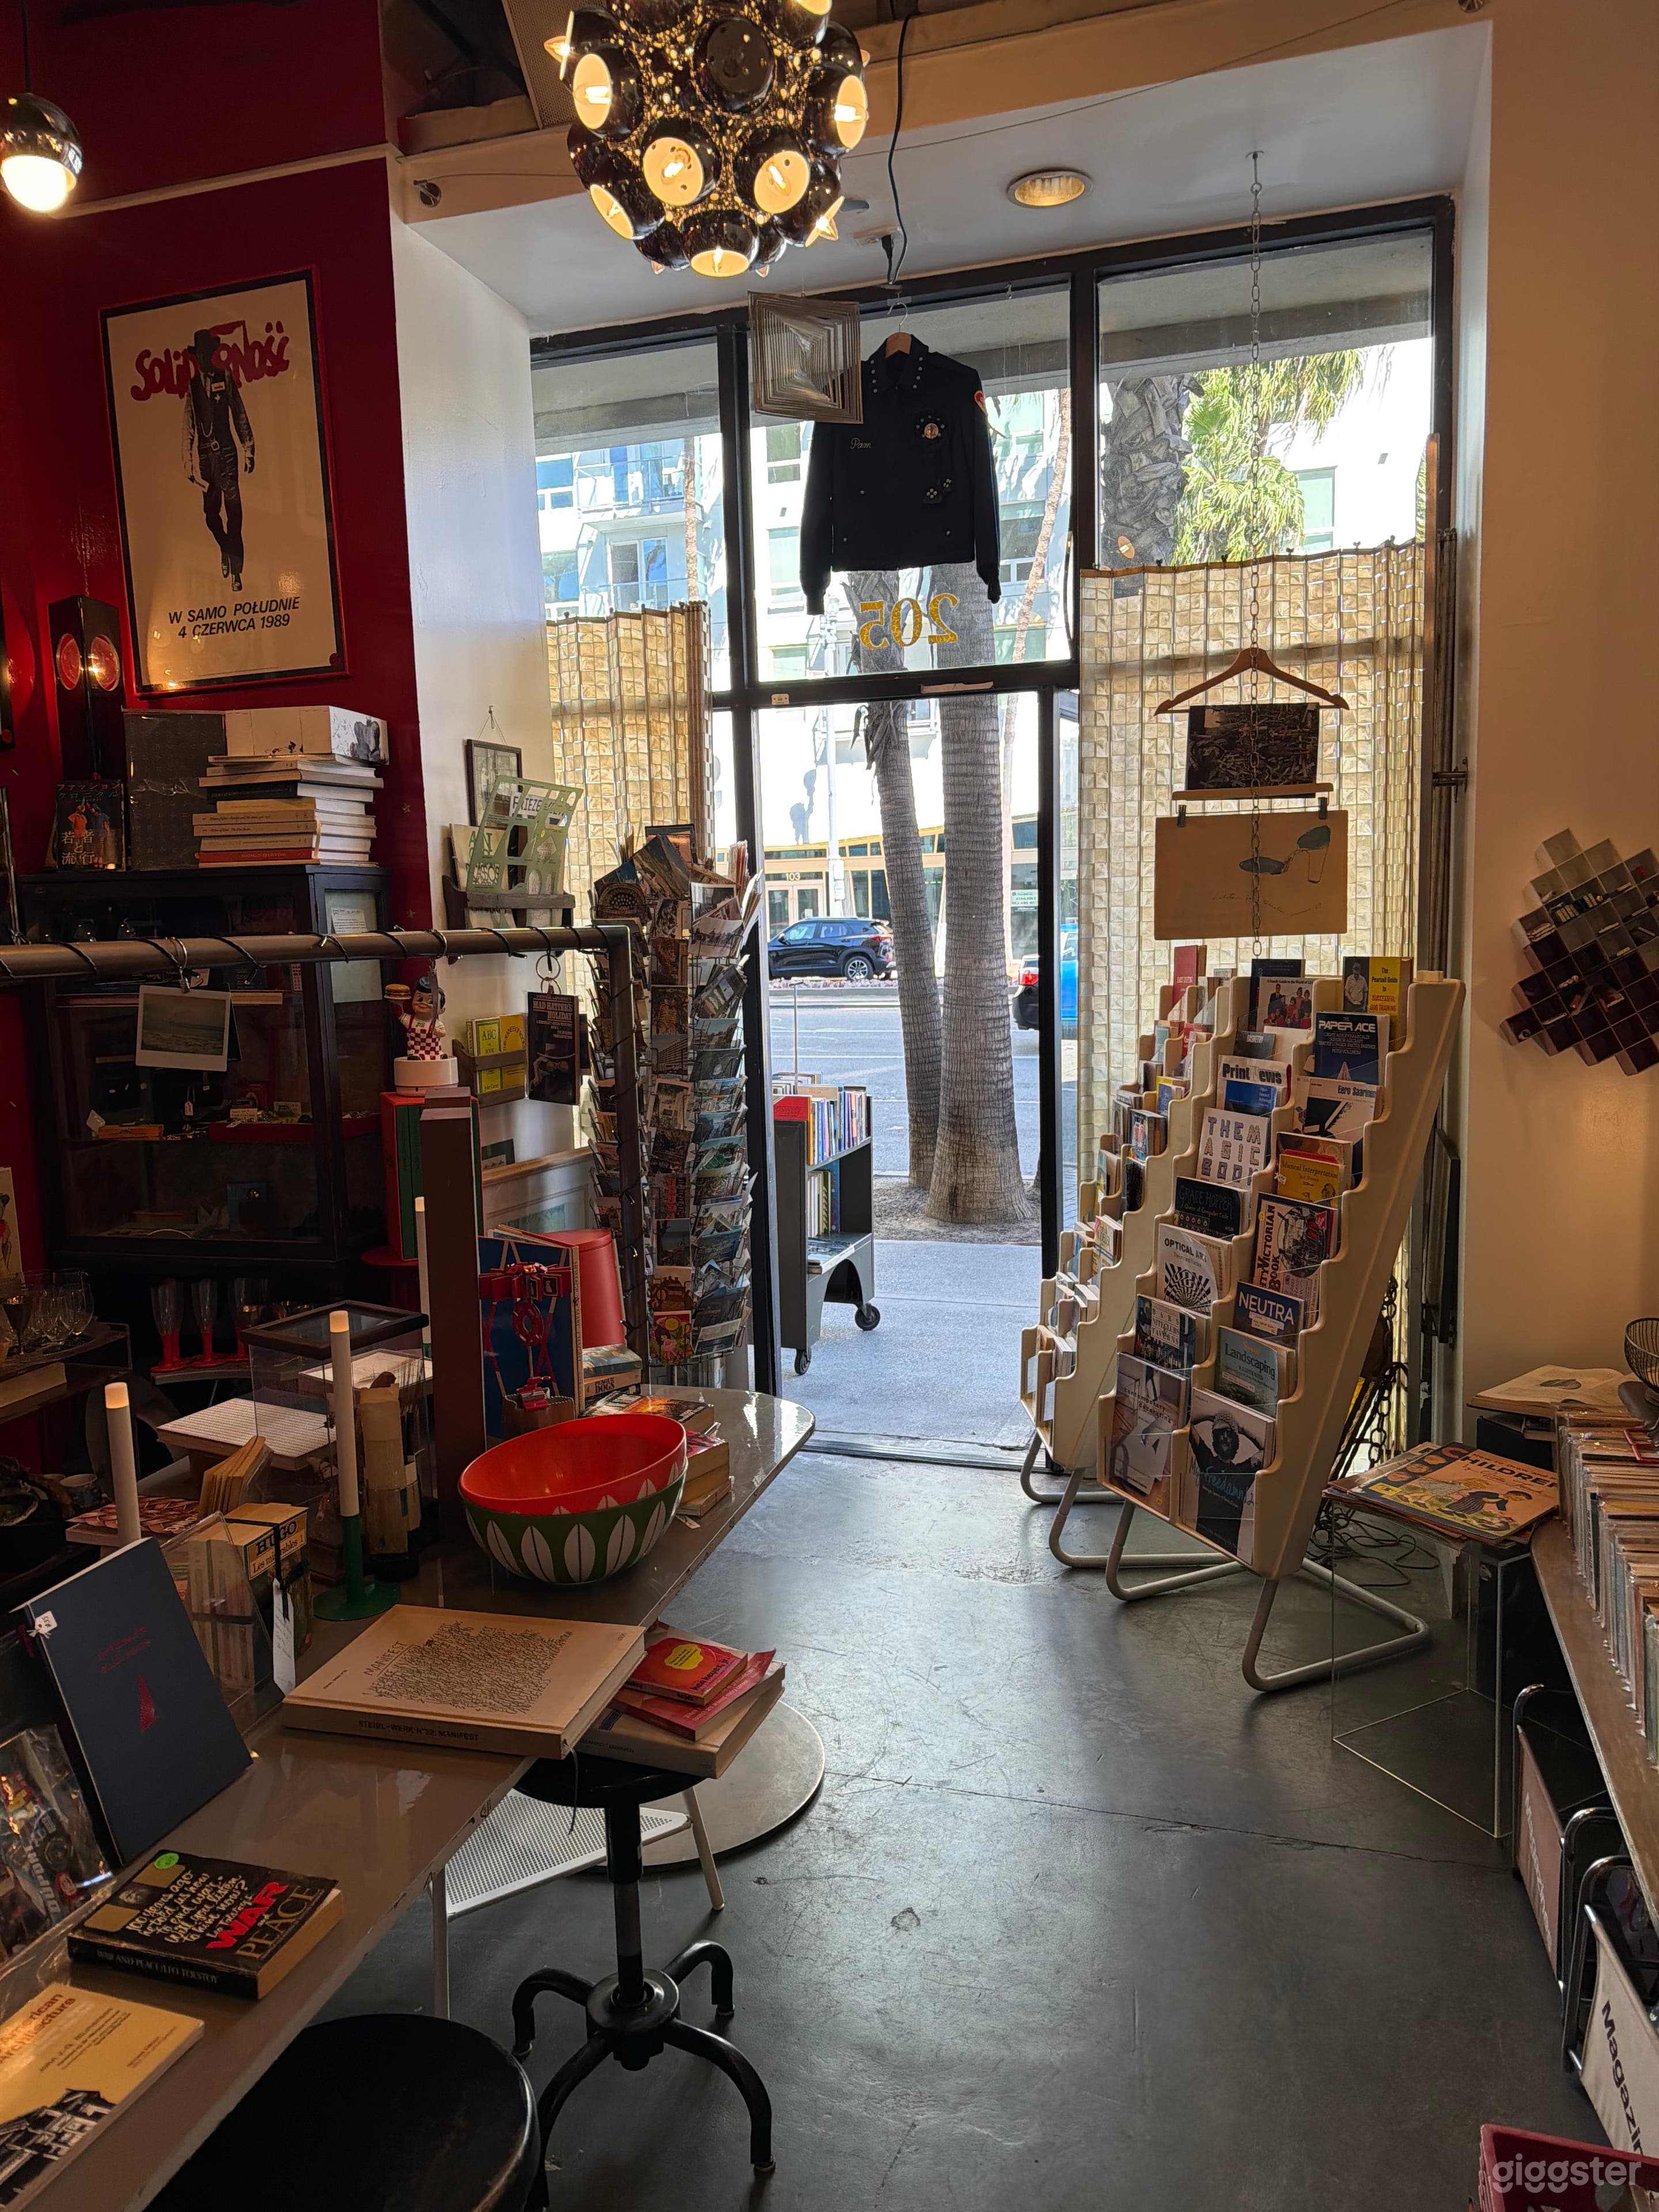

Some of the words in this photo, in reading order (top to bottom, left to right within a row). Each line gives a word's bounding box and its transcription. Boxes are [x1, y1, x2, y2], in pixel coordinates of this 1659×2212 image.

[850, 437, 872, 449] Pam
[169, 611, 183, 624] W
[187, 605, 227, 623] SAMO
[233, 597, 300, 616] POŁUDNIE
[178, 626, 187, 638] 4
[192, 618, 255, 637] CZERWCA
[261, 613, 290, 628] 1989
[62, 852, 95, 865] 流行
[786, 872, 801, 881] 103
[532, 1001, 546, 1010] MAD
[547, 1011, 573, 1021] HOLIDAY
[482, 1029, 497, 1041] ABC
[1318, 1020, 1353, 1032] PAPER
[1354, 1022, 1376, 1033] ACE
[1246, 1035, 1264, 1043] BASKETRY
[1222, 1063, 1250, 1080] Print
[1338, 1085, 1351, 1095] Eero
[1352, 1086, 1376, 1098] Saarinen
[1281, 1161, 1301, 1171] Musical
[1302, 1165, 1338, 1180] Interpretation
[1179, 1185, 1203, 1207] GRACE
[1205, 1191, 1232, 1212] HOPPER
[1257, 1205, 1275, 1270] VICTORIAN
[1164, 1237, 1194, 1256] OPTICAL
[1195, 1250, 1207, 1263] ART
[1268, 1254, 1281, 1292] BOOK
[1152, 1308, 1179, 1325] BARS
[1238, 1291, 1294, 1325] NEUTRA
[1152, 1327, 1179, 1344] TAVERNS
[1225, 1342, 1275, 1381] Landscaping
[594, 1381, 615, 1394] DOGS
[1124, 1387, 1165, 1411] contemporary
[1138, 1401, 1172, 1424] decorating
[255, 1520, 298, 1556] HUGO
[253, 1560, 265, 1573] Les
[266, 1540, 298, 1565] miables
[363, 1640, 407, 1676] MANIFEST
[438, 1730, 480, 1741] MANIFEST
[170, 1869, 195, 1894] ago
[187, 1873, 210, 1895] how
[190, 1905, 213, 1927] you
[207, 1875, 243, 1904] listen
[197, 1912, 221, 1934] him
[216, 1879, 249, 1911] now?
[170, 1906, 192, 1926] end
[205, 1881, 289, 1949] WAR
[234, 1885, 321, 1959] PEACE
[257, 1912, 271, 1927] and
